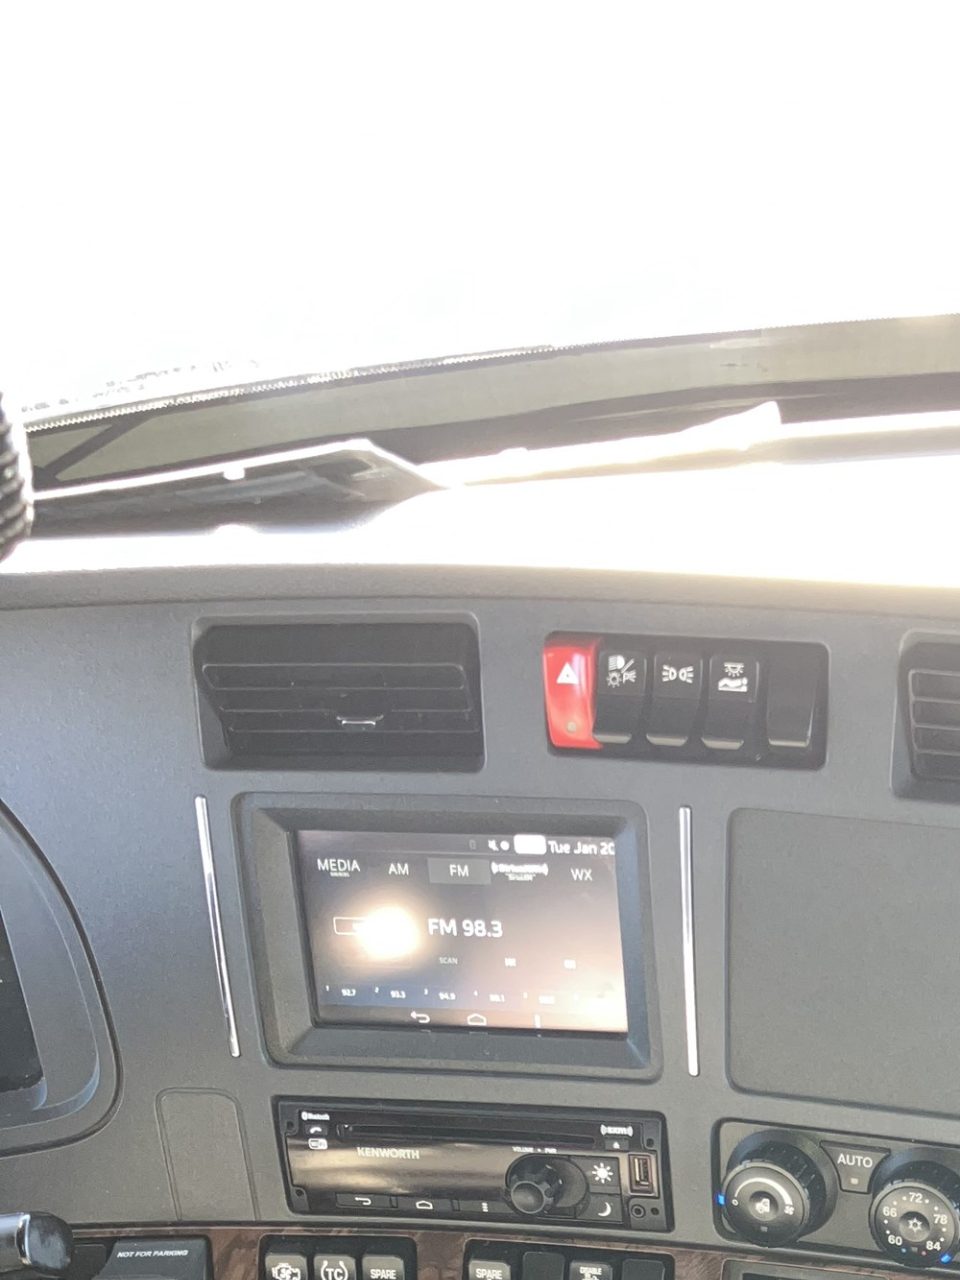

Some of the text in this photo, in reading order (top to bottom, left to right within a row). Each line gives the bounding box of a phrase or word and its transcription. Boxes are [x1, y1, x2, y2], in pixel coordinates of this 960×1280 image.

[548, 840, 570, 854] Tue
[573, 841, 597, 855] Jan
[317, 858, 361, 872] MEDIA
[388, 862, 409, 876] AM
[449, 863, 469, 877] FM
[570, 867, 593, 881] WX
[428, 918, 503, 938] FM 98.3
[357, 1147, 420, 1159] KENWORTH
[837, 1153, 873, 1168] AUTO
[909, 1193, 923, 1204] 72
[882, 1206, 897, 1217] 66
[933, 1213, 948, 1225] 78
[888, 1234, 903, 1246] 60
[926, 1240, 941, 1251] 84
[370, 1268, 397, 1280] SPARE
[475, 1268, 502, 1280] SPARE
